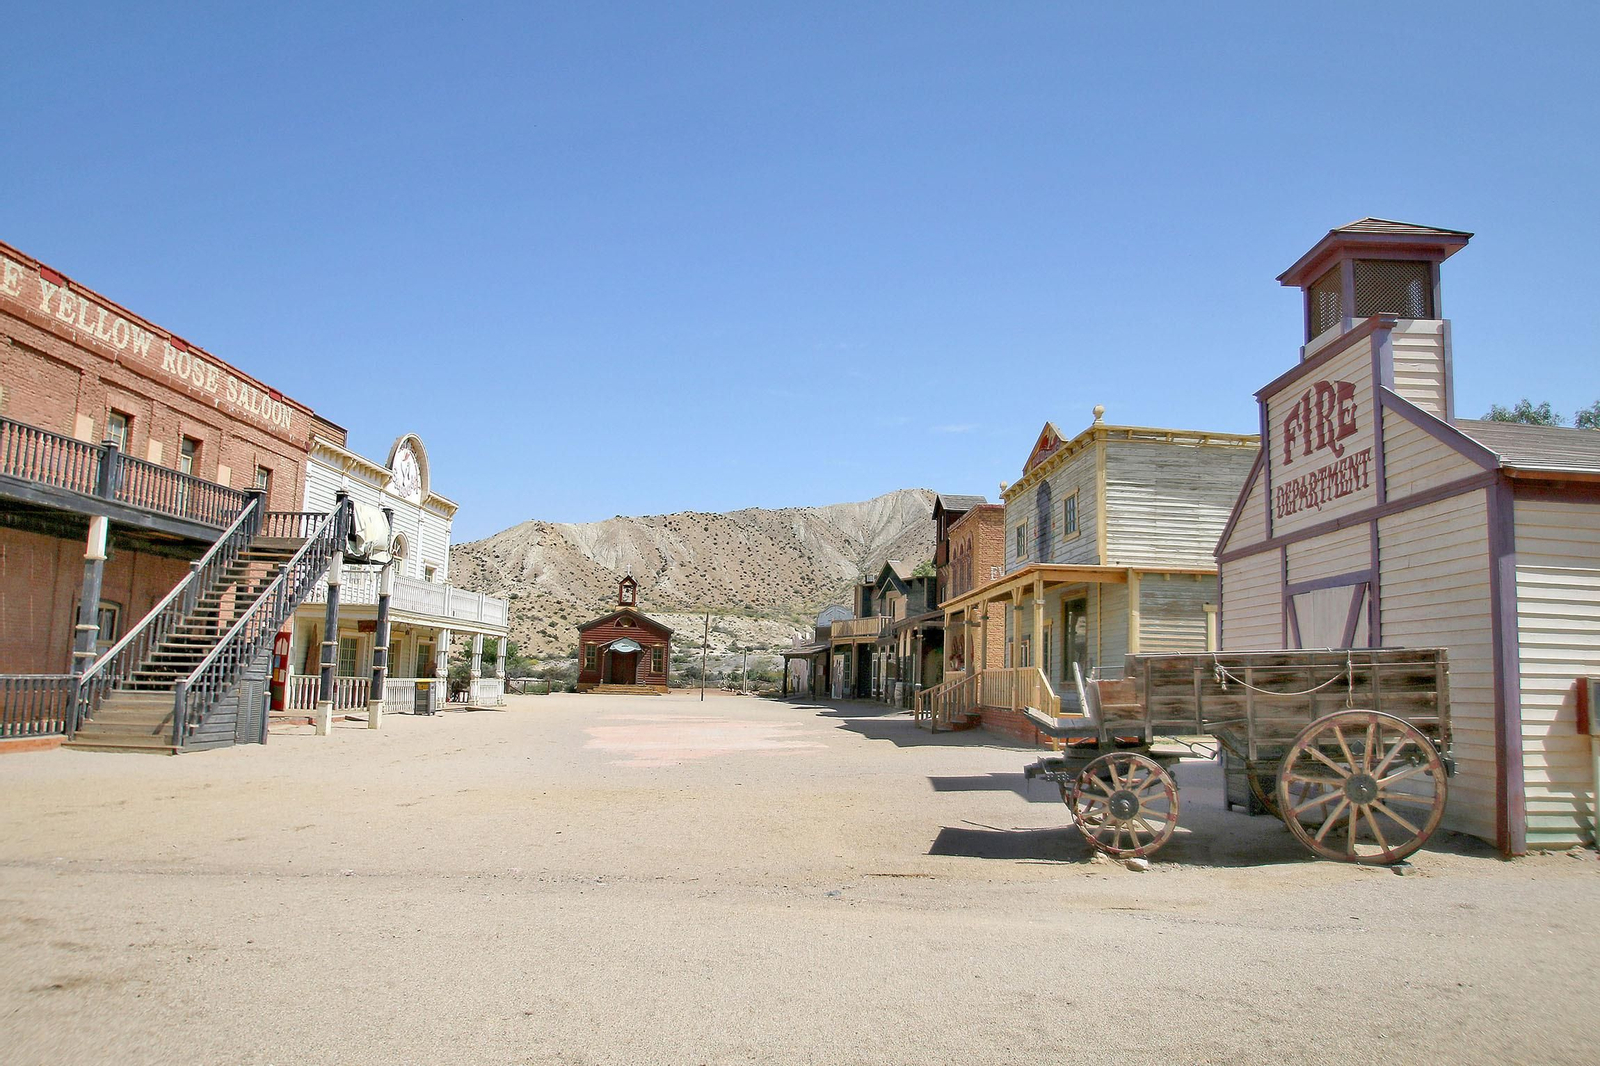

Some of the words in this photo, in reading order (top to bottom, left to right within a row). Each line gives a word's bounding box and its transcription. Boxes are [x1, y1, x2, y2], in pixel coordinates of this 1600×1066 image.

[39, 276, 154, 358] YELLOW
[160, 341, 220, 393] ROSE
[226, 375, 293, 430] SALOON
[1282, 380, 1358, 466] FIRE
[1275, 447, 1372, 519] DEPARTMENT
